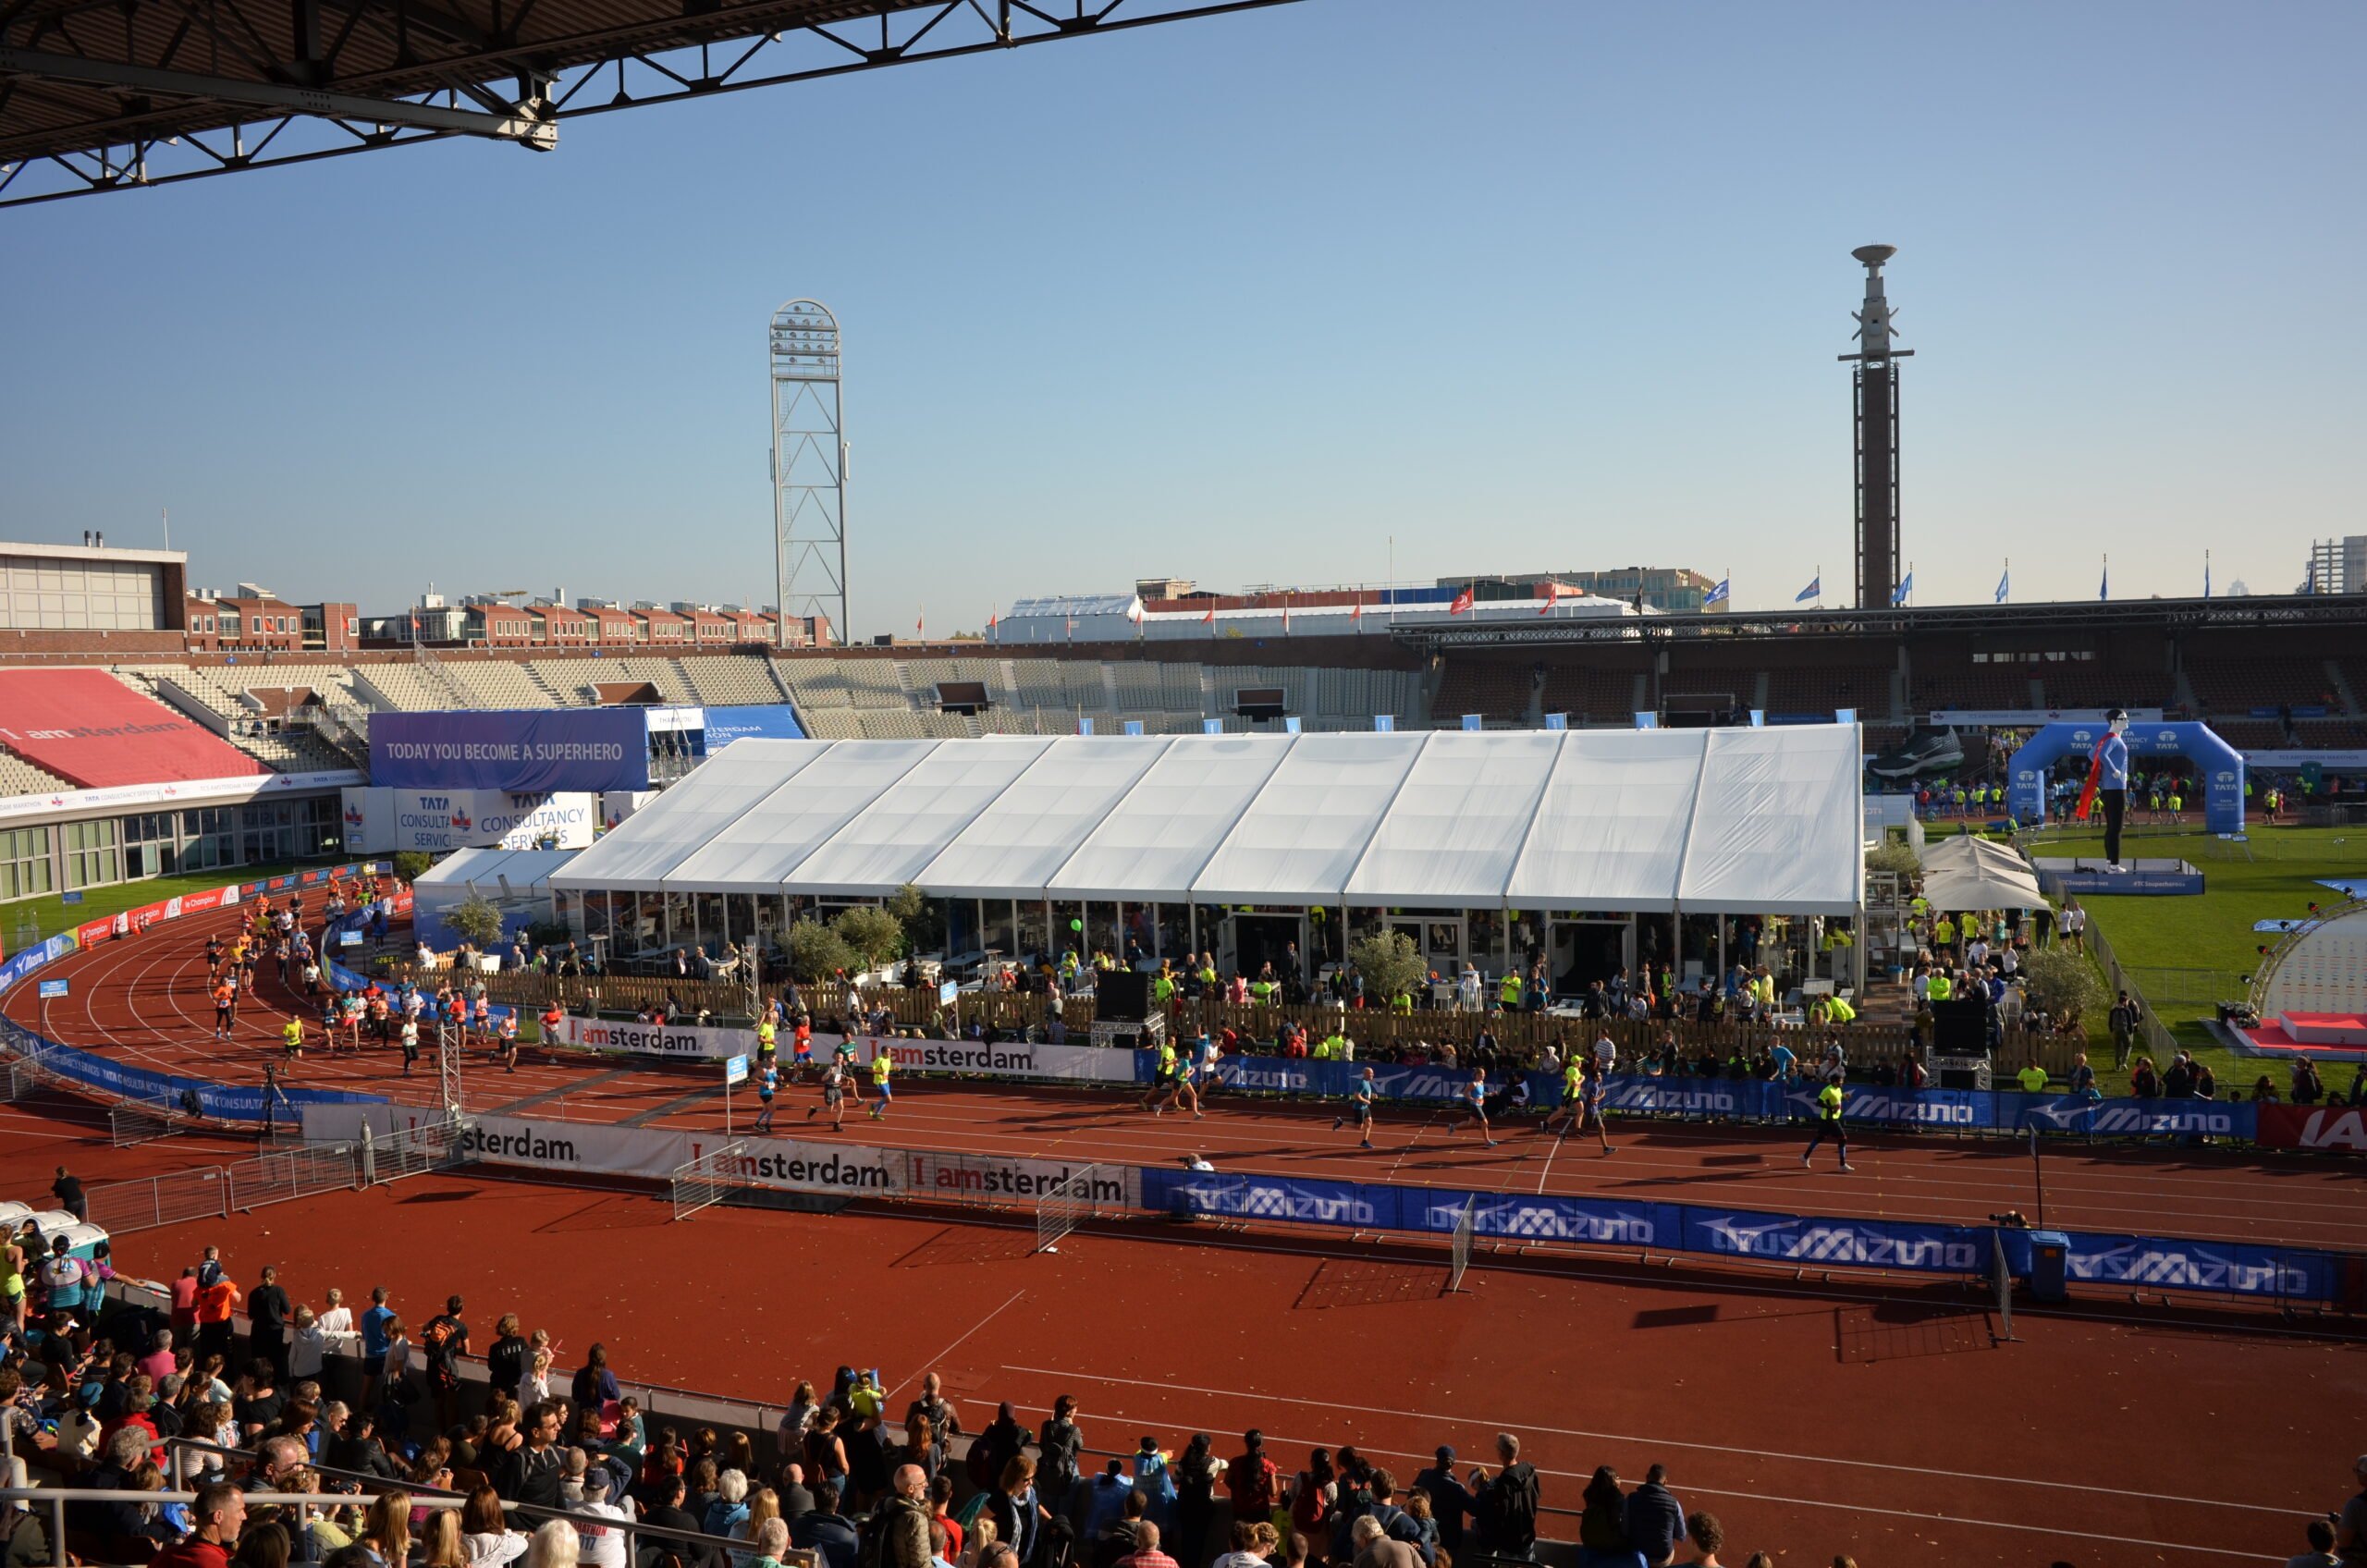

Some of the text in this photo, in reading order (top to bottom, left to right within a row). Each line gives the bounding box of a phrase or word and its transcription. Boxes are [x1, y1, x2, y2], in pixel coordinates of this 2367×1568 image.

[26, 722, 182, 740] amsterdam
[386, 742, 622, 761] TODAY YOU BECOME A SUPERHERO
[420, 797, 449, 811] TATA
[511, 792, 556, 809] TATA
[482, 808, 584, 832] CONSULTANCY
[570, 1019, 697, 1051] I amsterdam
[870, 1040, 1033, 1071] I amsterdam
[103, 1069, 117, 1083] TATA
[1213, 1063, 1306, 1089] MIZUNO
[1616, 1084, 1734, 1111] MIZUNO
[1847, 1095, 1973, 1123] MIZUNO
[2092, 1108, 2231, 1133] MIZUNO
[426, 1127, 574, 1162] asterdam
[693, 1143, 889, 1189] I amsterdam
[914, 1157, 1122, 1202] I amsterdam
[1241, 1188, 1375, 1224] MIZUNO
[1502, 1207, 1654, 1243] MIZUNO
[1784, 1228, 1978, 1268] MIZUNO
[202, 1264, 212, 1282] 7
[2119, 1253, 2309, 1294] MIZUNO
